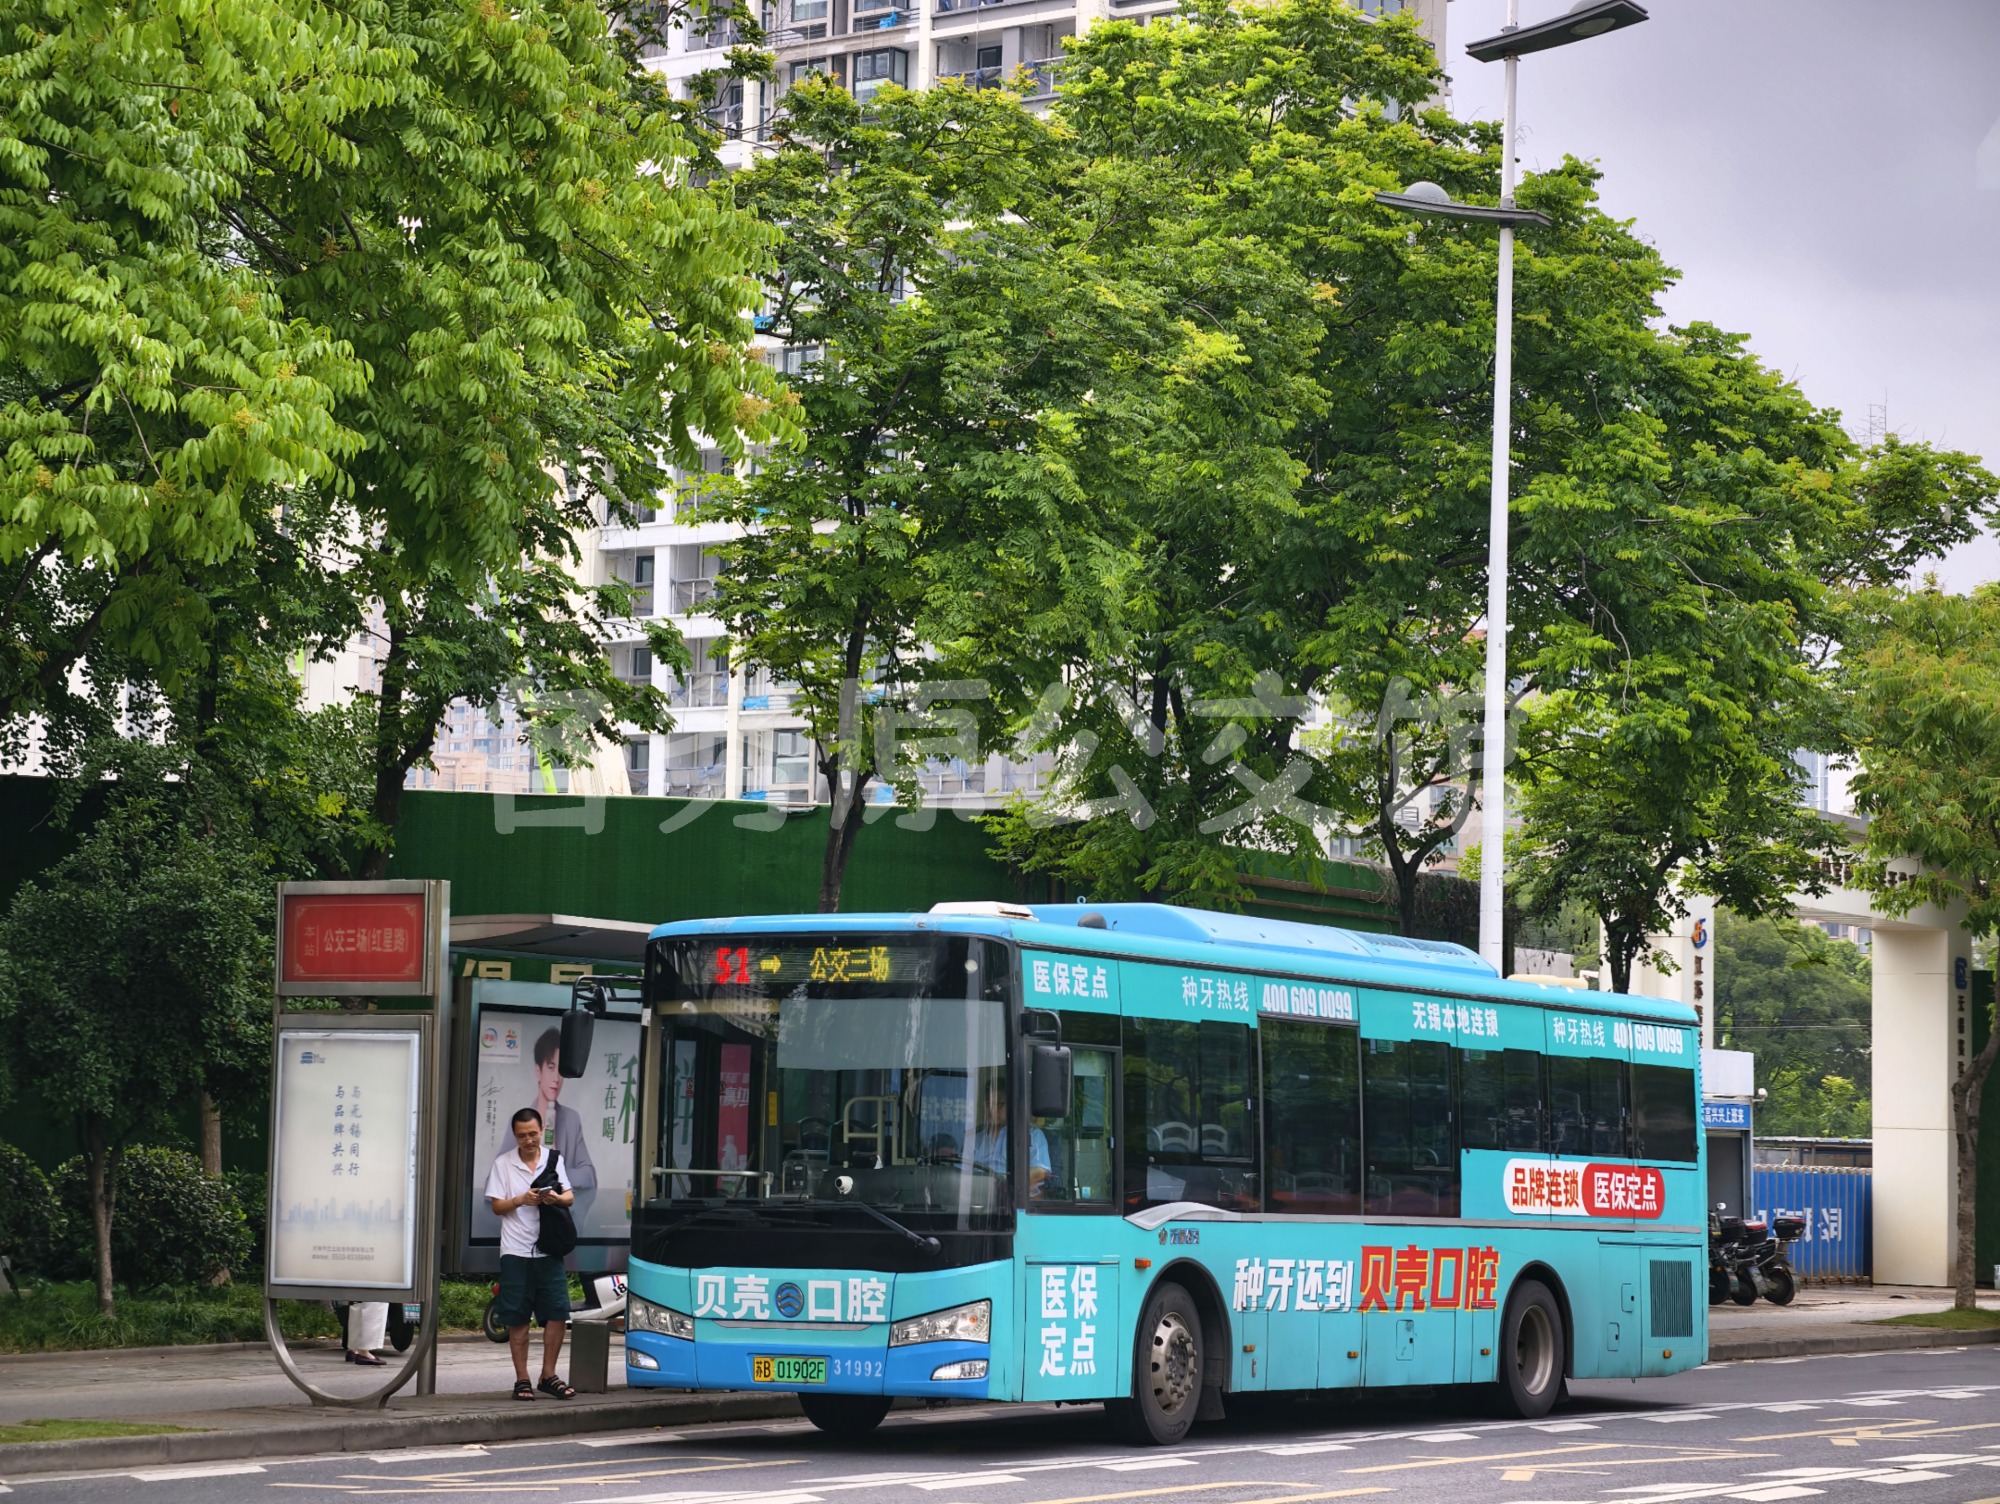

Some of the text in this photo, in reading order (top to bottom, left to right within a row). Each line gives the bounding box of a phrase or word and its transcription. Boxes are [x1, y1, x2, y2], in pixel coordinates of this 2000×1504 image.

[715, 946, 751, 985] 51
[810, 946, 892, 984] 公交三场
[1032, 960, 1110, 1000] 医保定点
[1181, 976, 1353, 1020] 种牙热线 400 609 0099
[1412, 1001, 1500, 1039] 无锡本地连锁
[1553, 1016, 1606, 1049] 种牙热线
[1634, 1026, 1656, 1052] 609
[1657, 1028, 1684, 1055] 0099
[331, 1085, 346, 1176] 与品牌共兴
[347, 1085, 362, 1176] 与无锡同行
[1703, 1107, 1745, 1125] 高兴兴上班来
[1512, 1168, 1579, 1209] 品牌连锁
[1593, 1171, 1658, 1212] 医保定点
[613, 1283, 628, 1298] 18
[694, 1273, 887, 1323] 贝壳 口腔
[1041, 1265, 1098, 1320] 医保
[833, 1359, 883, 1377] 31992
[1039, 1321, 1097, 1378] 定点
